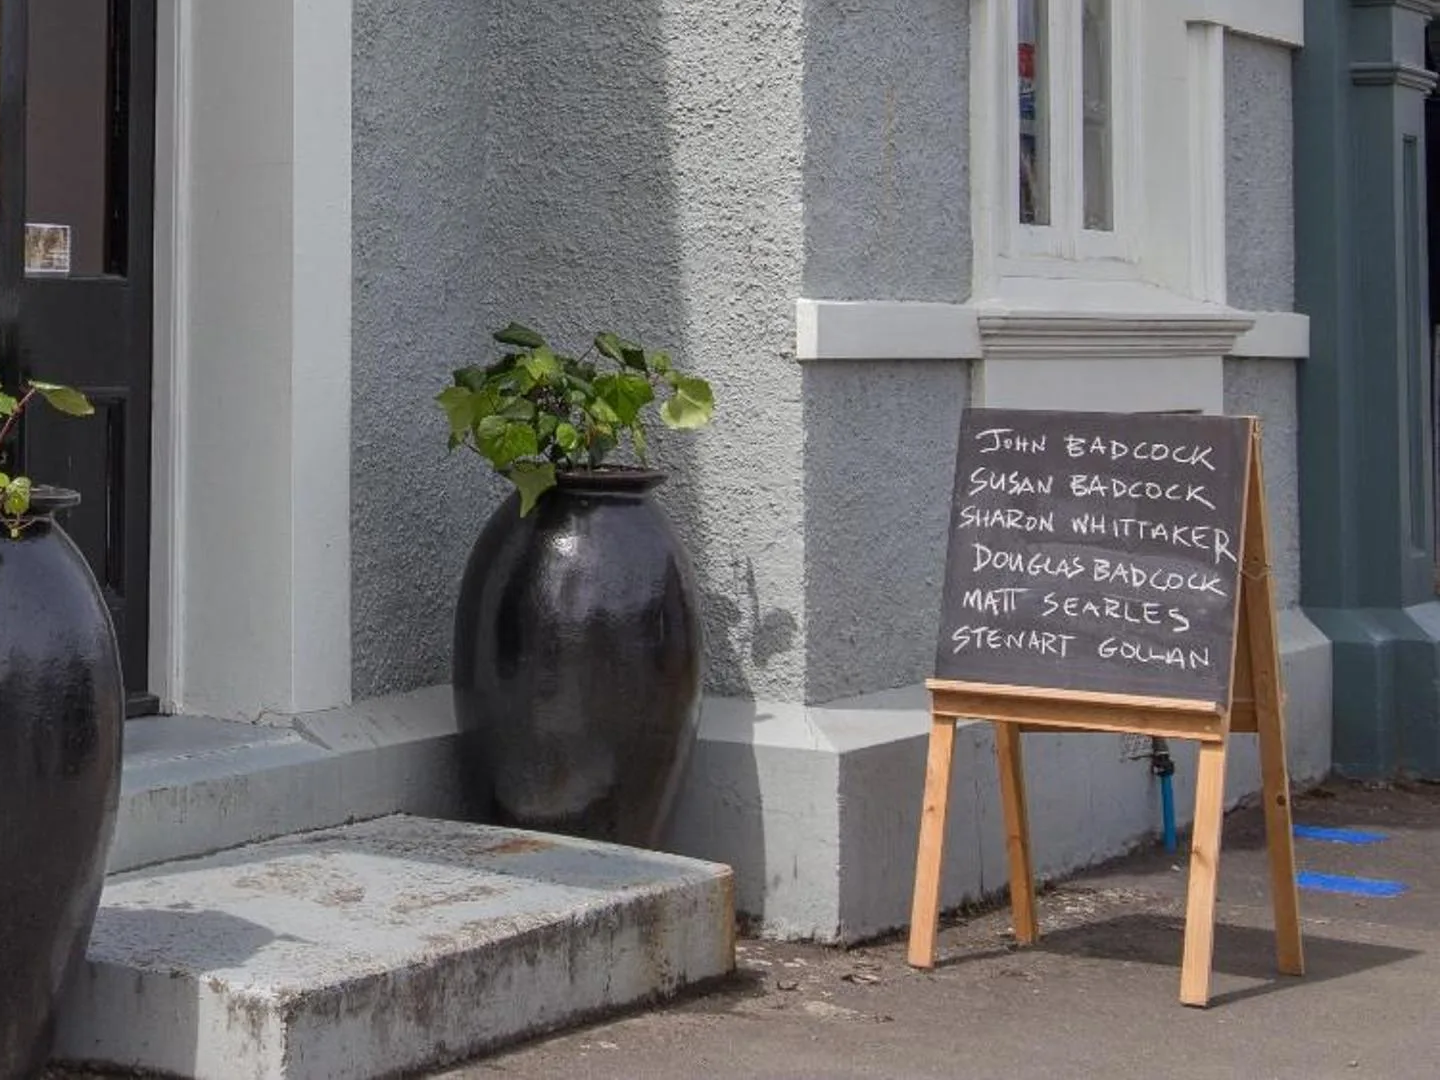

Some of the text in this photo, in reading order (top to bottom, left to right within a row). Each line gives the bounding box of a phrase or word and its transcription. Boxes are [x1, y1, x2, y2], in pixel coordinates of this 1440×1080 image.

[975, 428, 1216, 471] JOHN BADCOCK
[968, 467, 1216, 510] SUSAN BADCOCK
[959, 506, 1237, 564] SHARON WHITTAKER
[973, 543, 1227, 596] DOUGLAS BADCOCK
[963, 588, 1190, 632] MATT SEARLES
[952, 626, 1210, 669] STEWART GOLLAN
